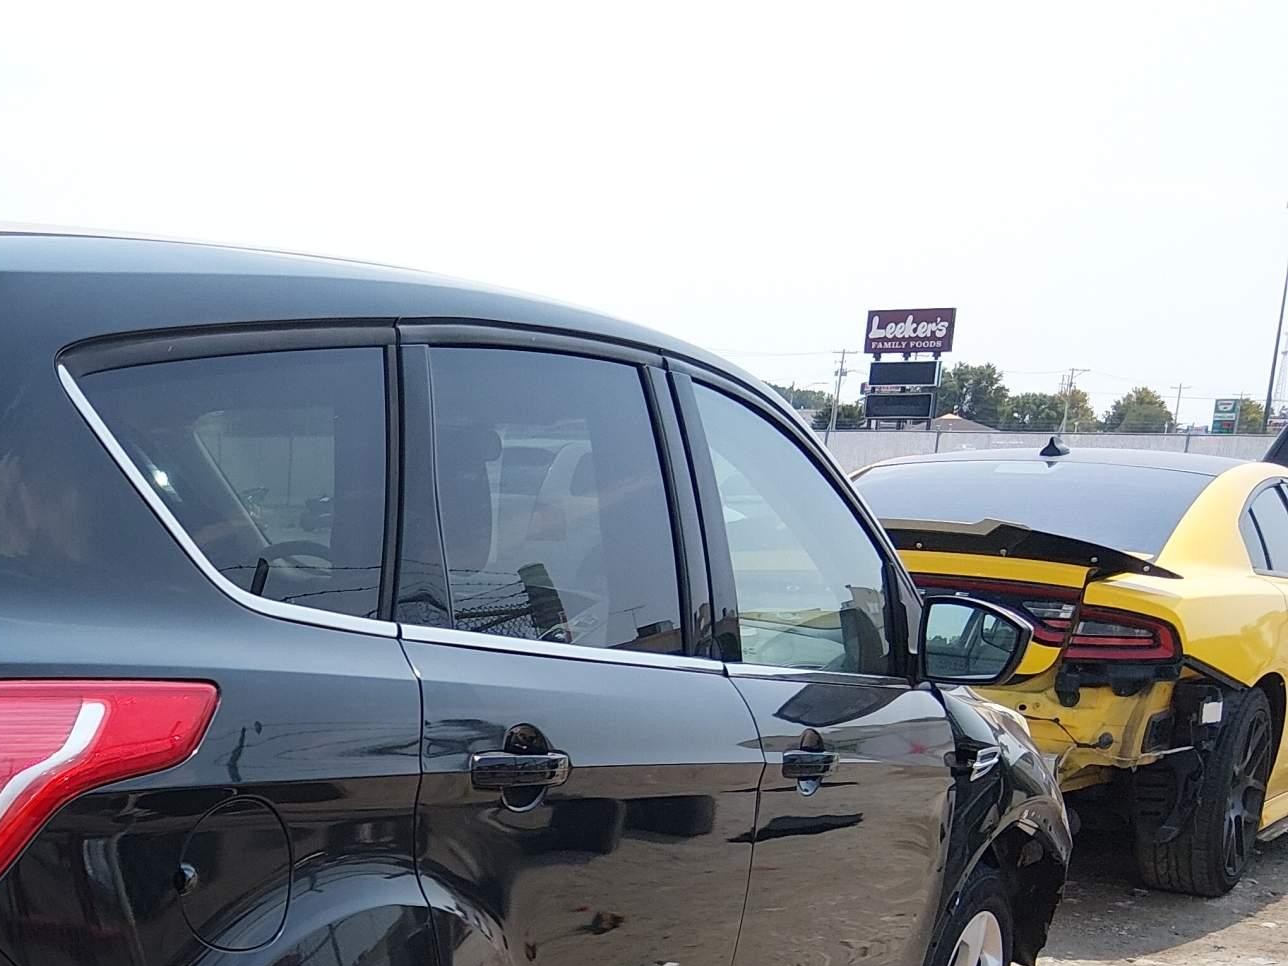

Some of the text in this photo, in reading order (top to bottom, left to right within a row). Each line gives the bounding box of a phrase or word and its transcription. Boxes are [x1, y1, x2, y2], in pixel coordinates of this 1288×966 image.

[869, 315, 949, 339] Leeker's
[872, 340, 943, 349] FAMILY FOODS
